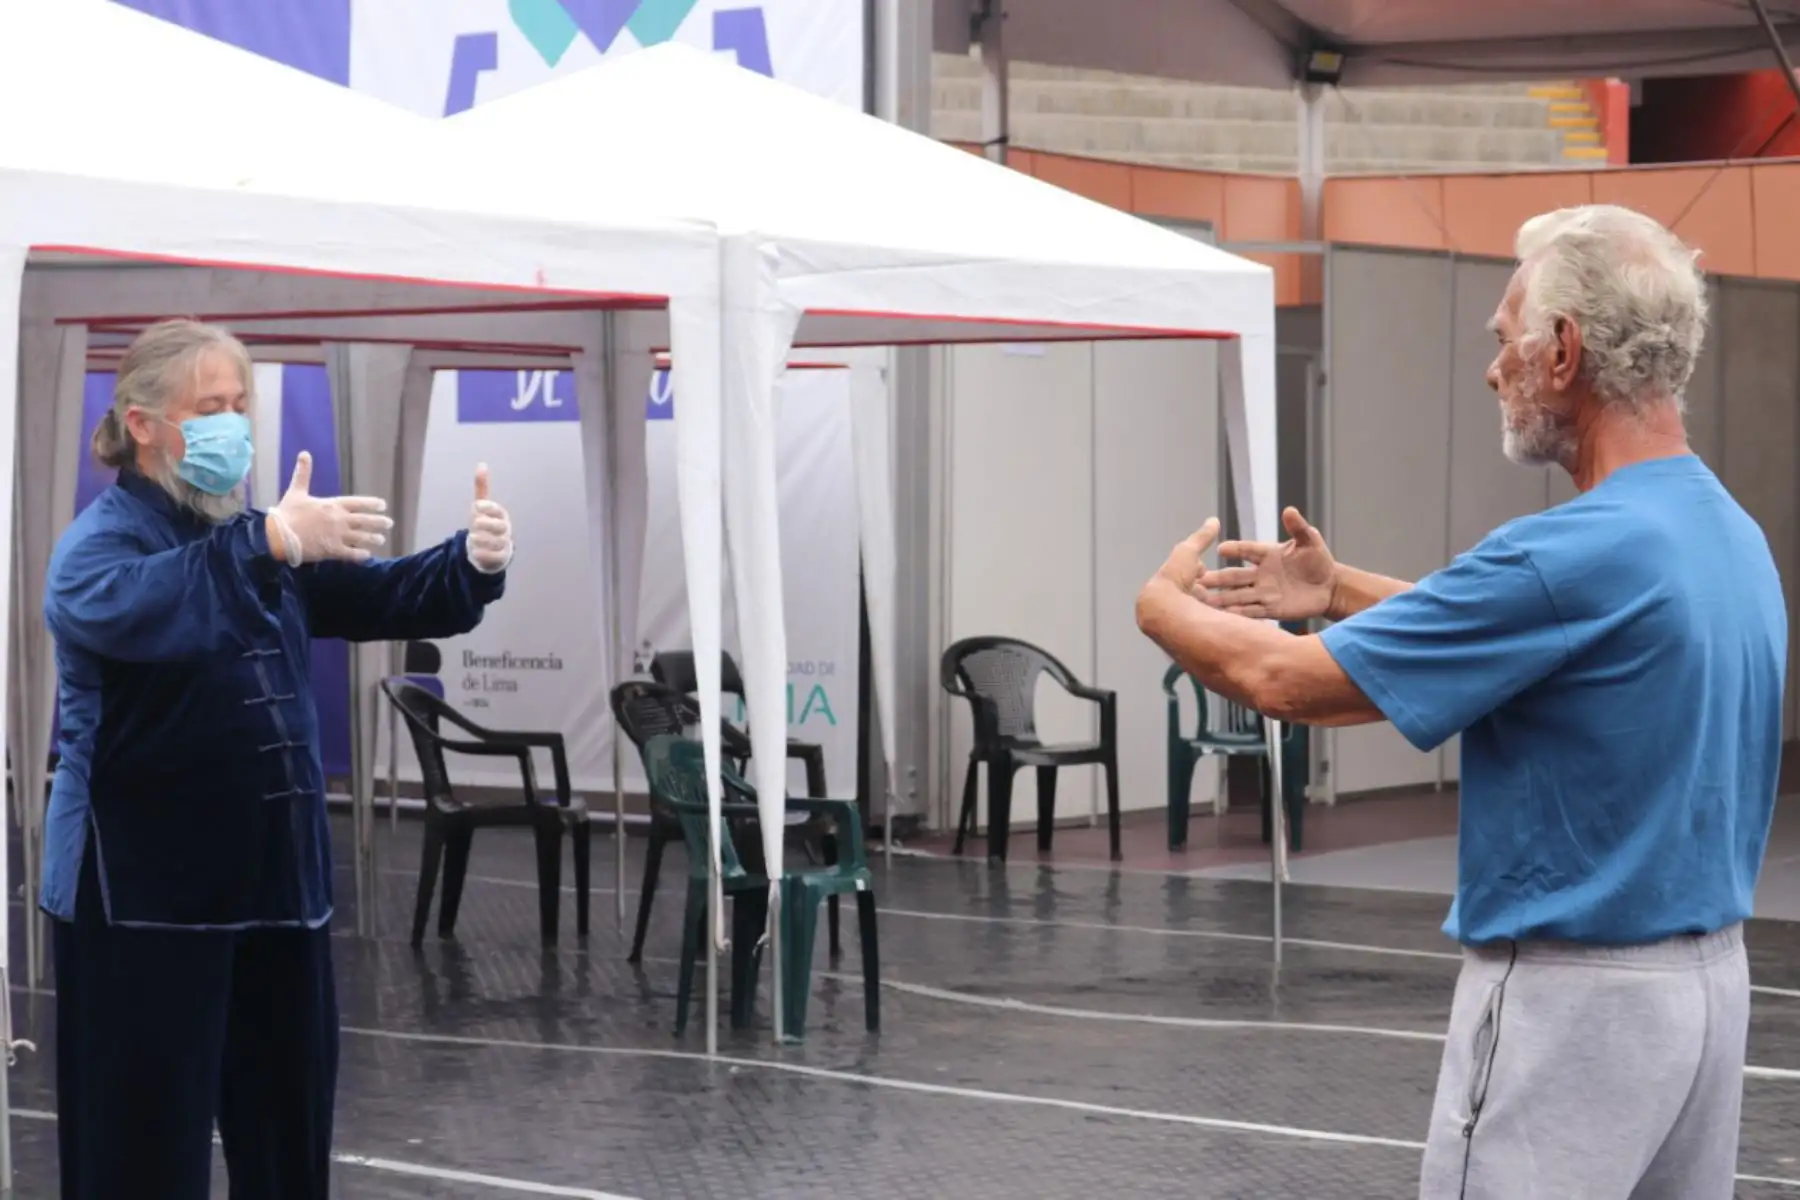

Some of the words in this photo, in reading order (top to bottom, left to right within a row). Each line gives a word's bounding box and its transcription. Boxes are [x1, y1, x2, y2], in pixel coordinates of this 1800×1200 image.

[462, 649, 563, 670] Beneficencia
[461, 673, 480, 691] de
[482, 672, 518, 693] Lima
